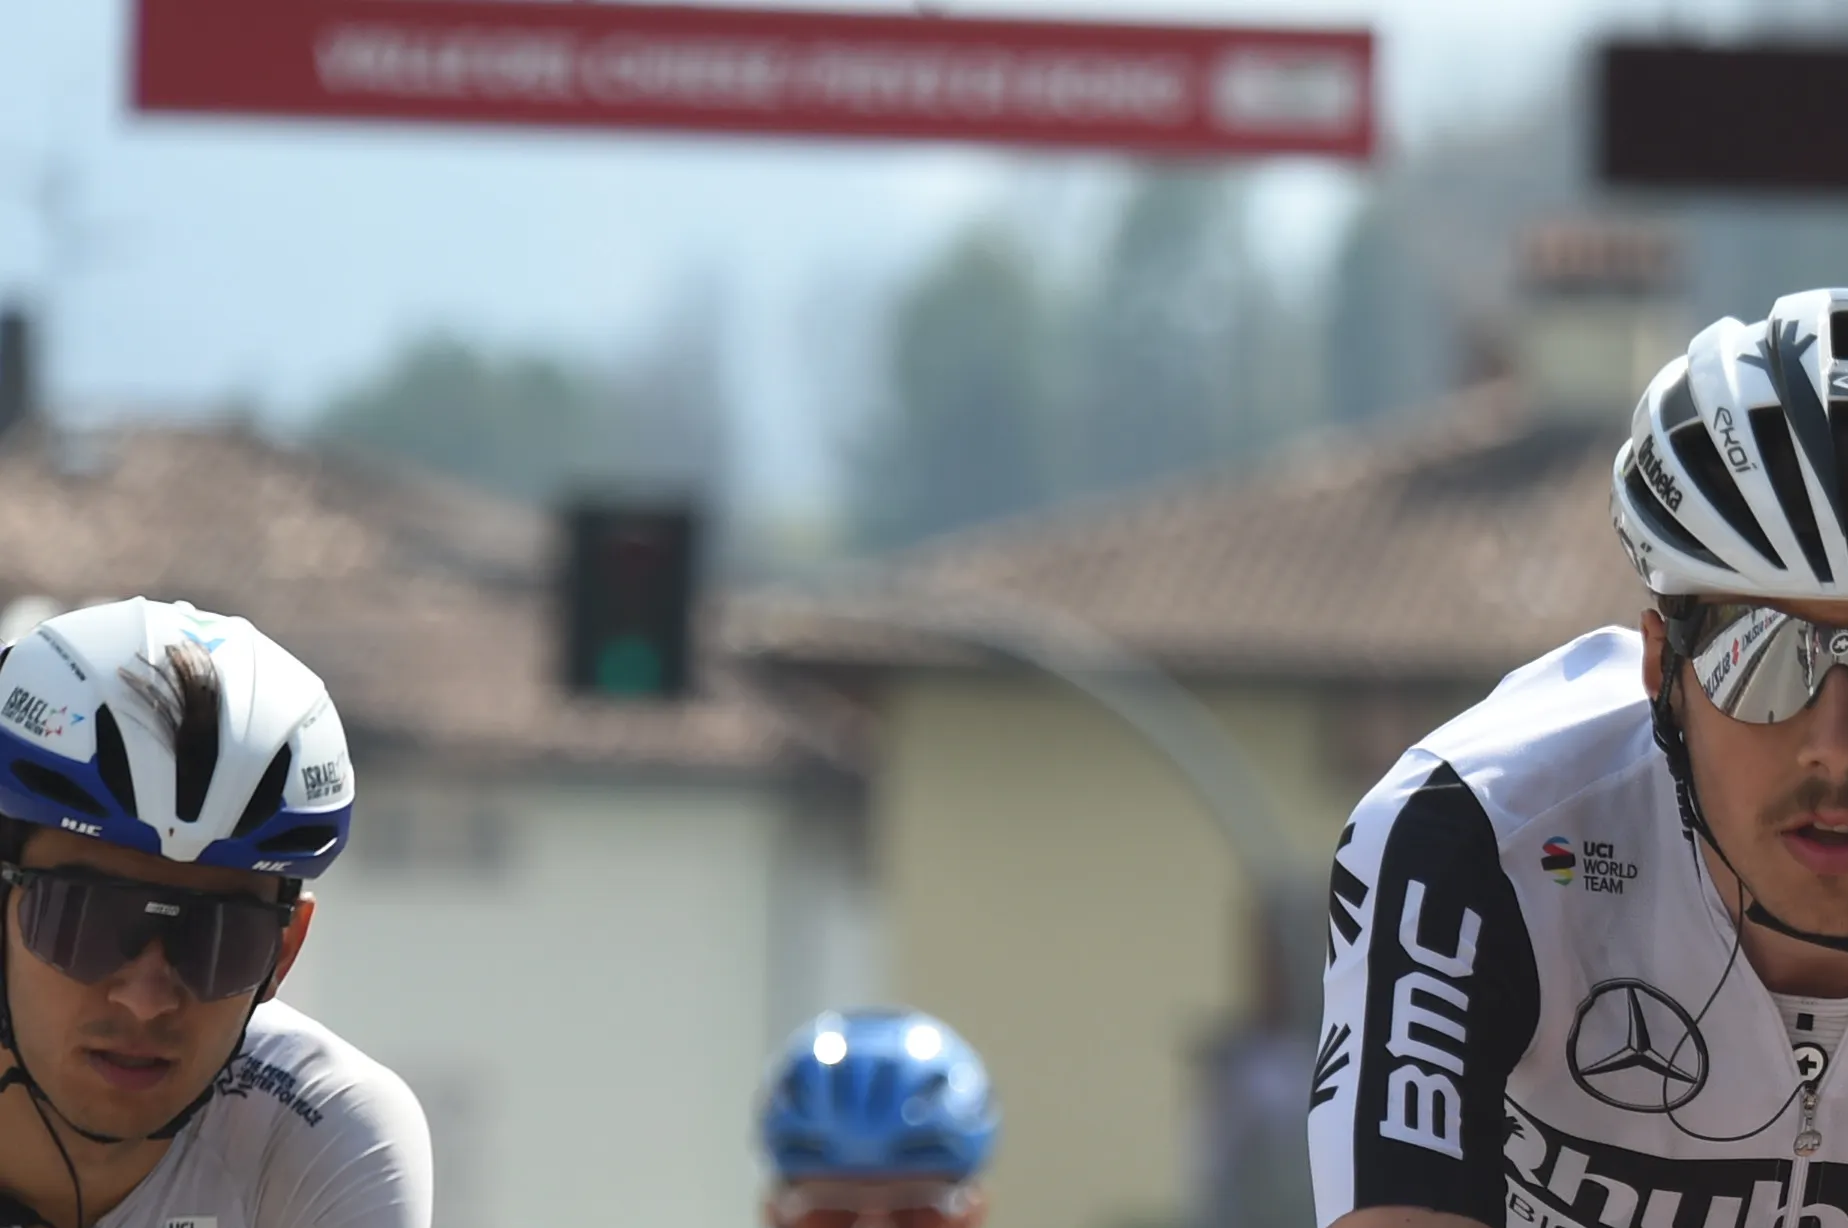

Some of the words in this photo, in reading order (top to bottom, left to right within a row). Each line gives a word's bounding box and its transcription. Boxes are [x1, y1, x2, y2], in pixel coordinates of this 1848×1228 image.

[5, 686, 48, 723] ISRAEL
[1582, 841, 1614, 859] UCI
[1583, 858, 1638, 879] WORLD
[1583, 875, 1624, 895] TEAM
[1379, 879, 1482, 1160] BMC
